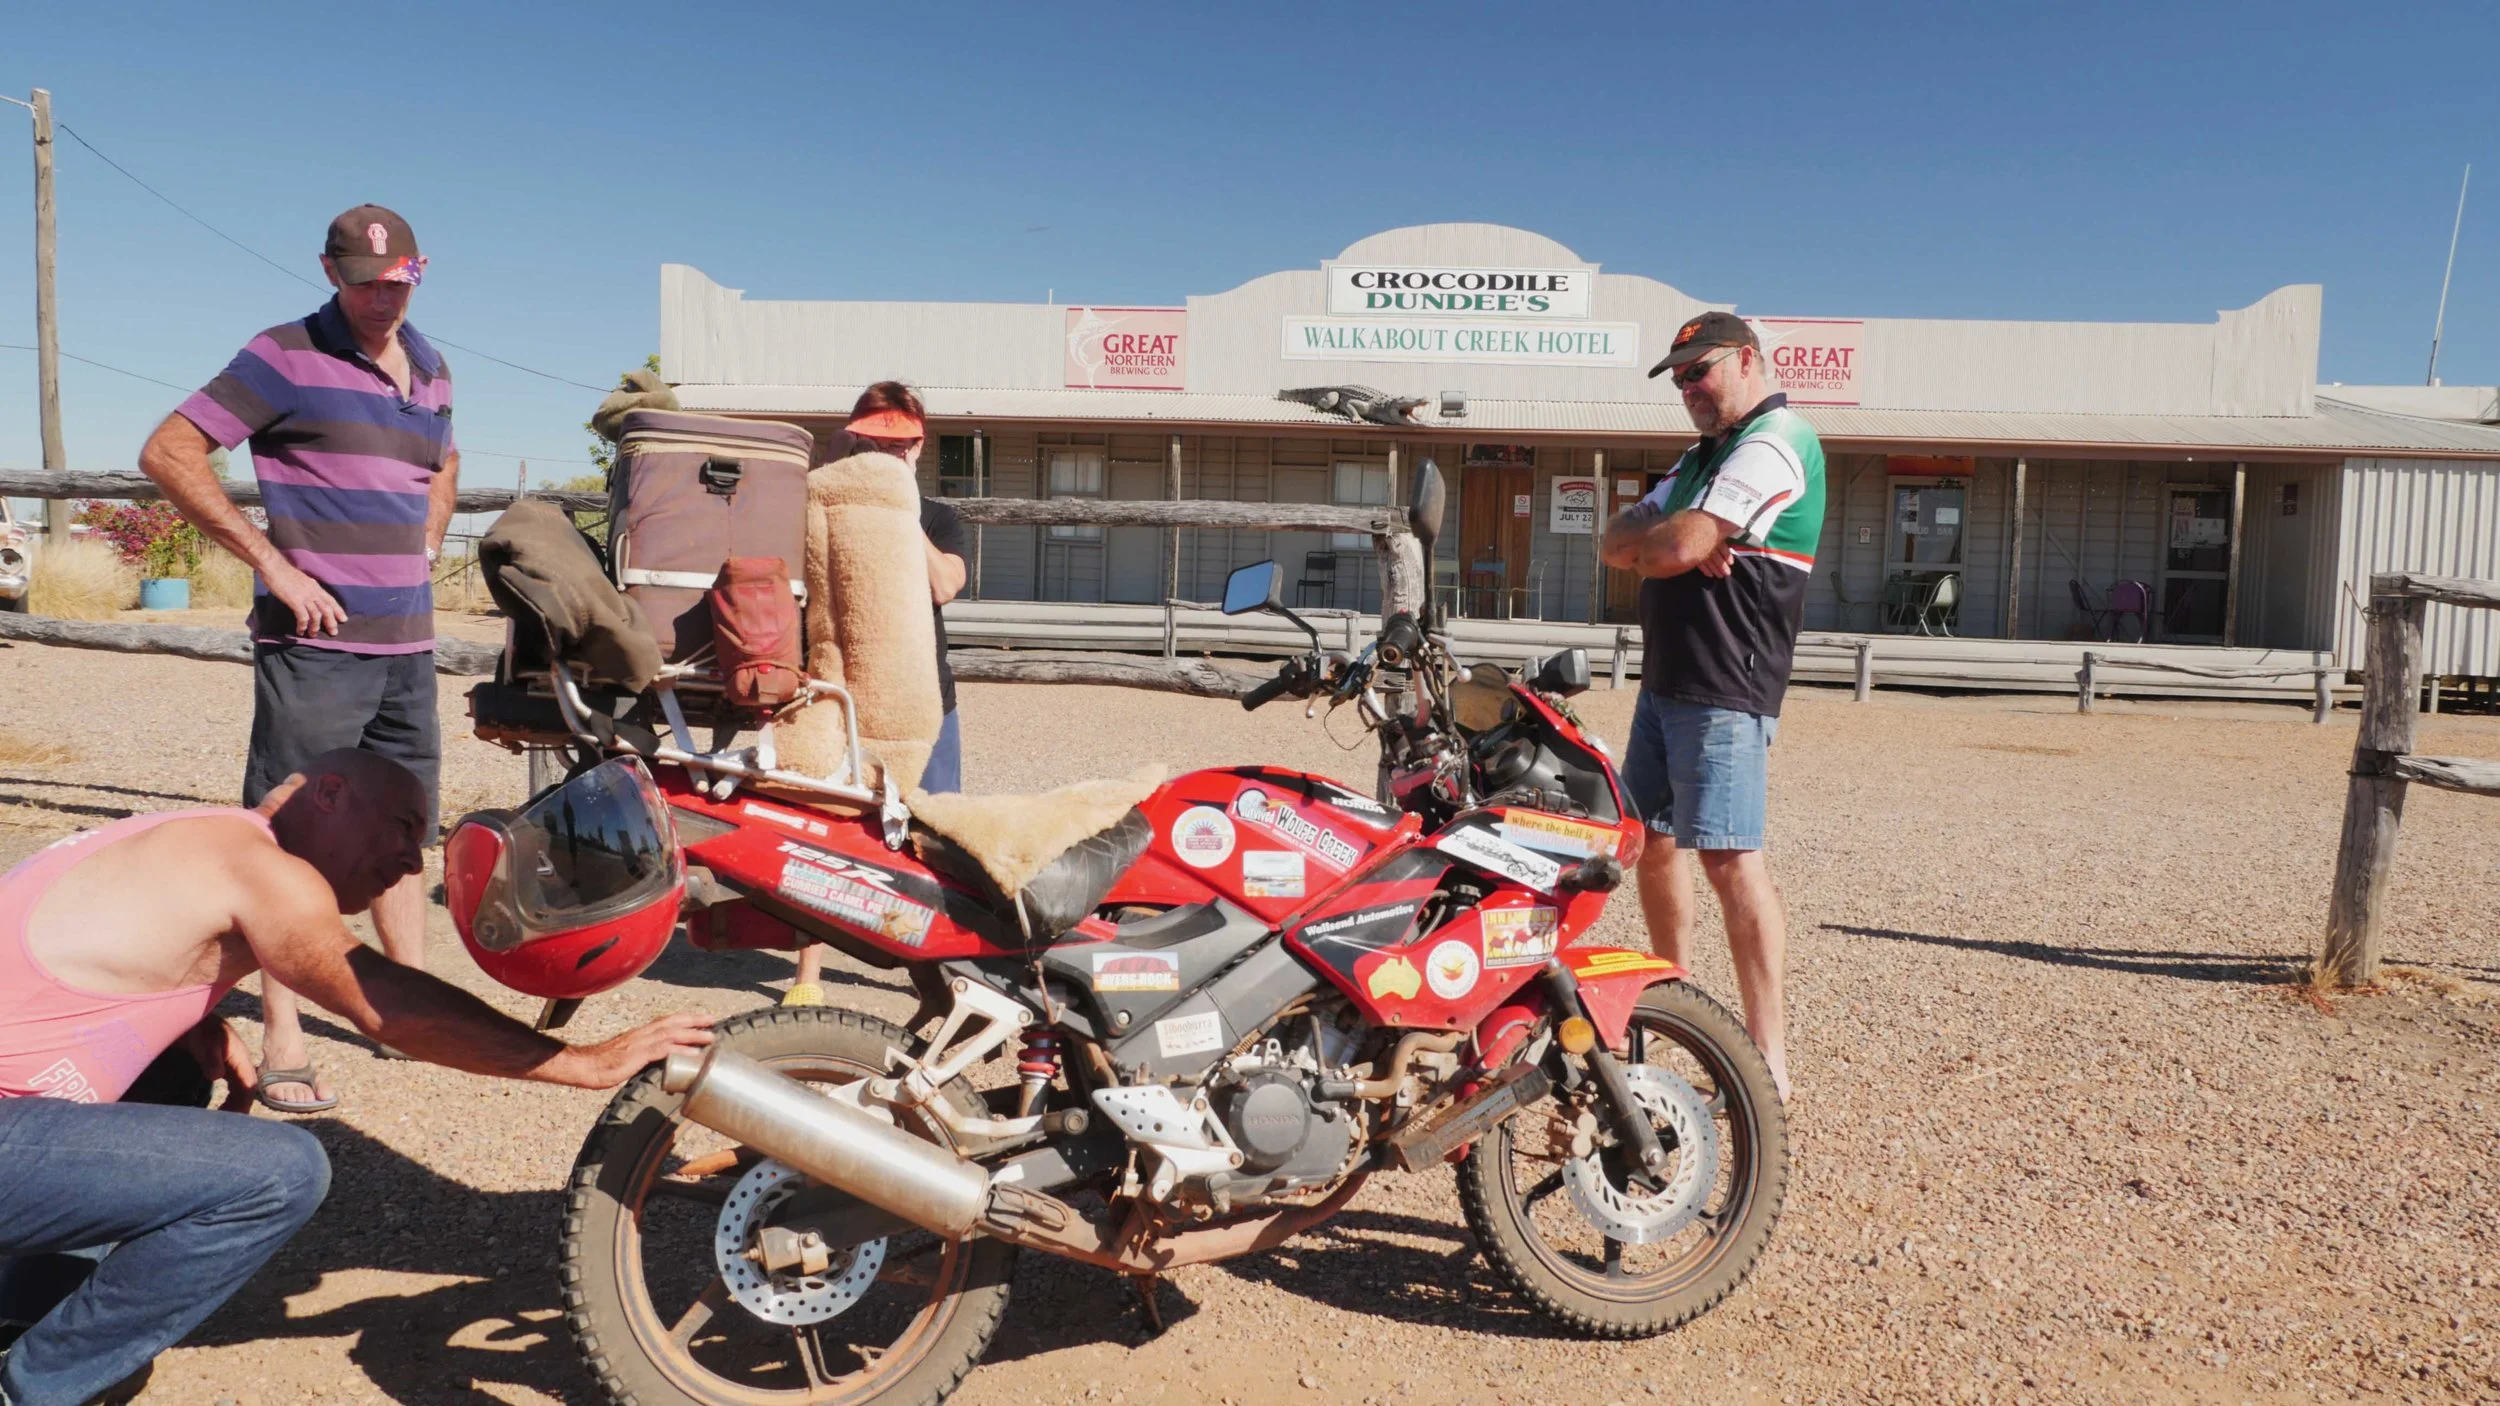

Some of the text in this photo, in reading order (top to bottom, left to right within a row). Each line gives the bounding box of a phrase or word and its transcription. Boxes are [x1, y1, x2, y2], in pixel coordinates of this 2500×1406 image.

[1350, 271, 1569, 292] CROCODILE
[1366, 292, 1550, 312] DUNDEE'S
[1103, 334, 1178, 354] GREAT
[1303, 326, 1615, 355] WALKABOUT CREEK HOTEL
[1105, 355, 1175, 366] NORTHERN
[1773, 346, 1855, 368] GREAT
[1110, 367, 1151, 376] BREWING
[1774, 368, 1852, 380] NORTHERN
[1780, 380, 1824, 389] BREWING
[1559, 513, 1580, 521] JULY
[1331, 797, 1386, 814] HONDA
[1512, 815, 1593, 839] where the hell is
[1316, 827, 1359, 868] CREEK
[782, 876, 829, 898] CURRIED
[828, 889, 867, 911] CAMEL
[1304, 903, 1415, 937] Wallsend Automotive
